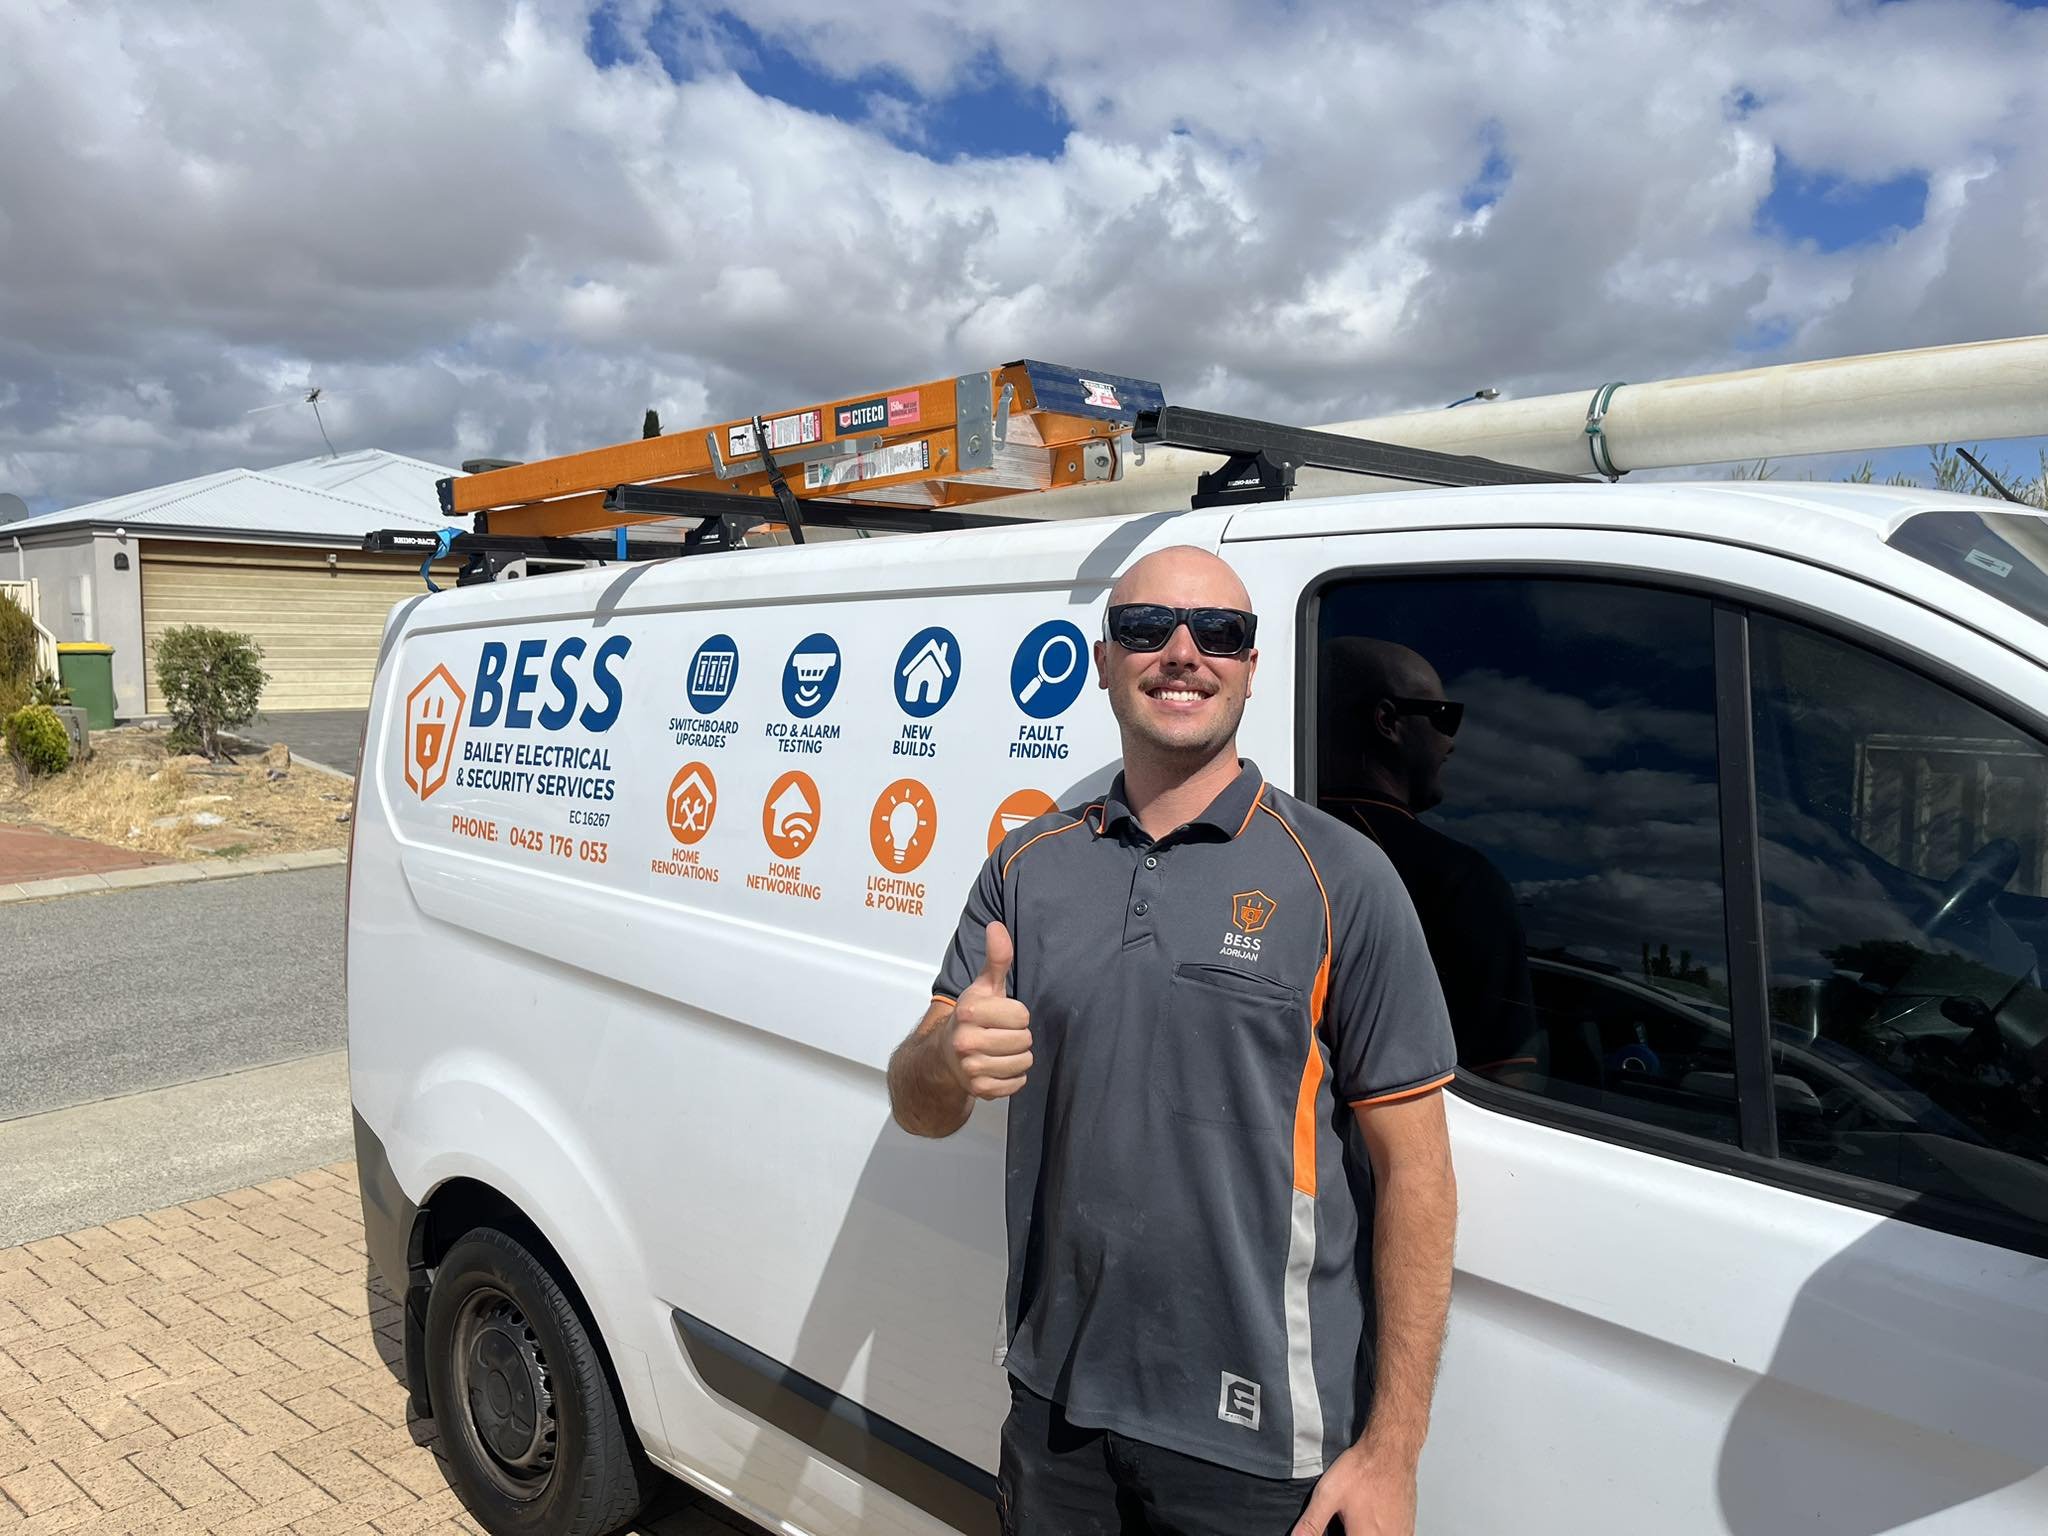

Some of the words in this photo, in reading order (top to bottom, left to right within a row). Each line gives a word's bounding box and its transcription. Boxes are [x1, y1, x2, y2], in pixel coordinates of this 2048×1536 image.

[852, 405, 884, 425] CITECO
[469, 635, 632, 733] BESS
[669, 718, 739, 734] SWITCHBOARD
[765, 724, 788, 738] RCD
[790, 724, 799, 738] &
[800, 724, 841, 740] ALARM
[901, 724, 932, 740] NEW
[1018, 725, 1064, 742] FAULT
[675, 733, 726, 748] UPGRADES
[778, 739, 823, 753] TESTING
[892, 741, 936, 758] BUILDS
[464, 741, 514, 764] BAILEY
[516, 745, 611, 771] ELECTRICAL
[1009, 743, 1069, 760] FINDING
[456, 767, 464, 786] &
[466, 768, 535, 792] SECURITY
[536, 774, 615, 801] SERVICES
[452, 815, 498, 841] PHONE:
[510, 827, 543, 851] 0425
[550, 835, 573, 858] 176
[579, 840, 608, 863] 053
[671, 848, 699, 864] HOME
[651, 860, 719, 883] RENOVATIONS
[768, 862, 801, 880] HOME
[746, 875, 821, 901] NETWORKING
[867, 876, 925, 899] LIGHTING
[865, 893, 875, 909] &
[877, 895, 924, 917] POWER
[1224, 932, 1261, 951] BESS
[1219, 946, 1258, 961] ADRIJAN
